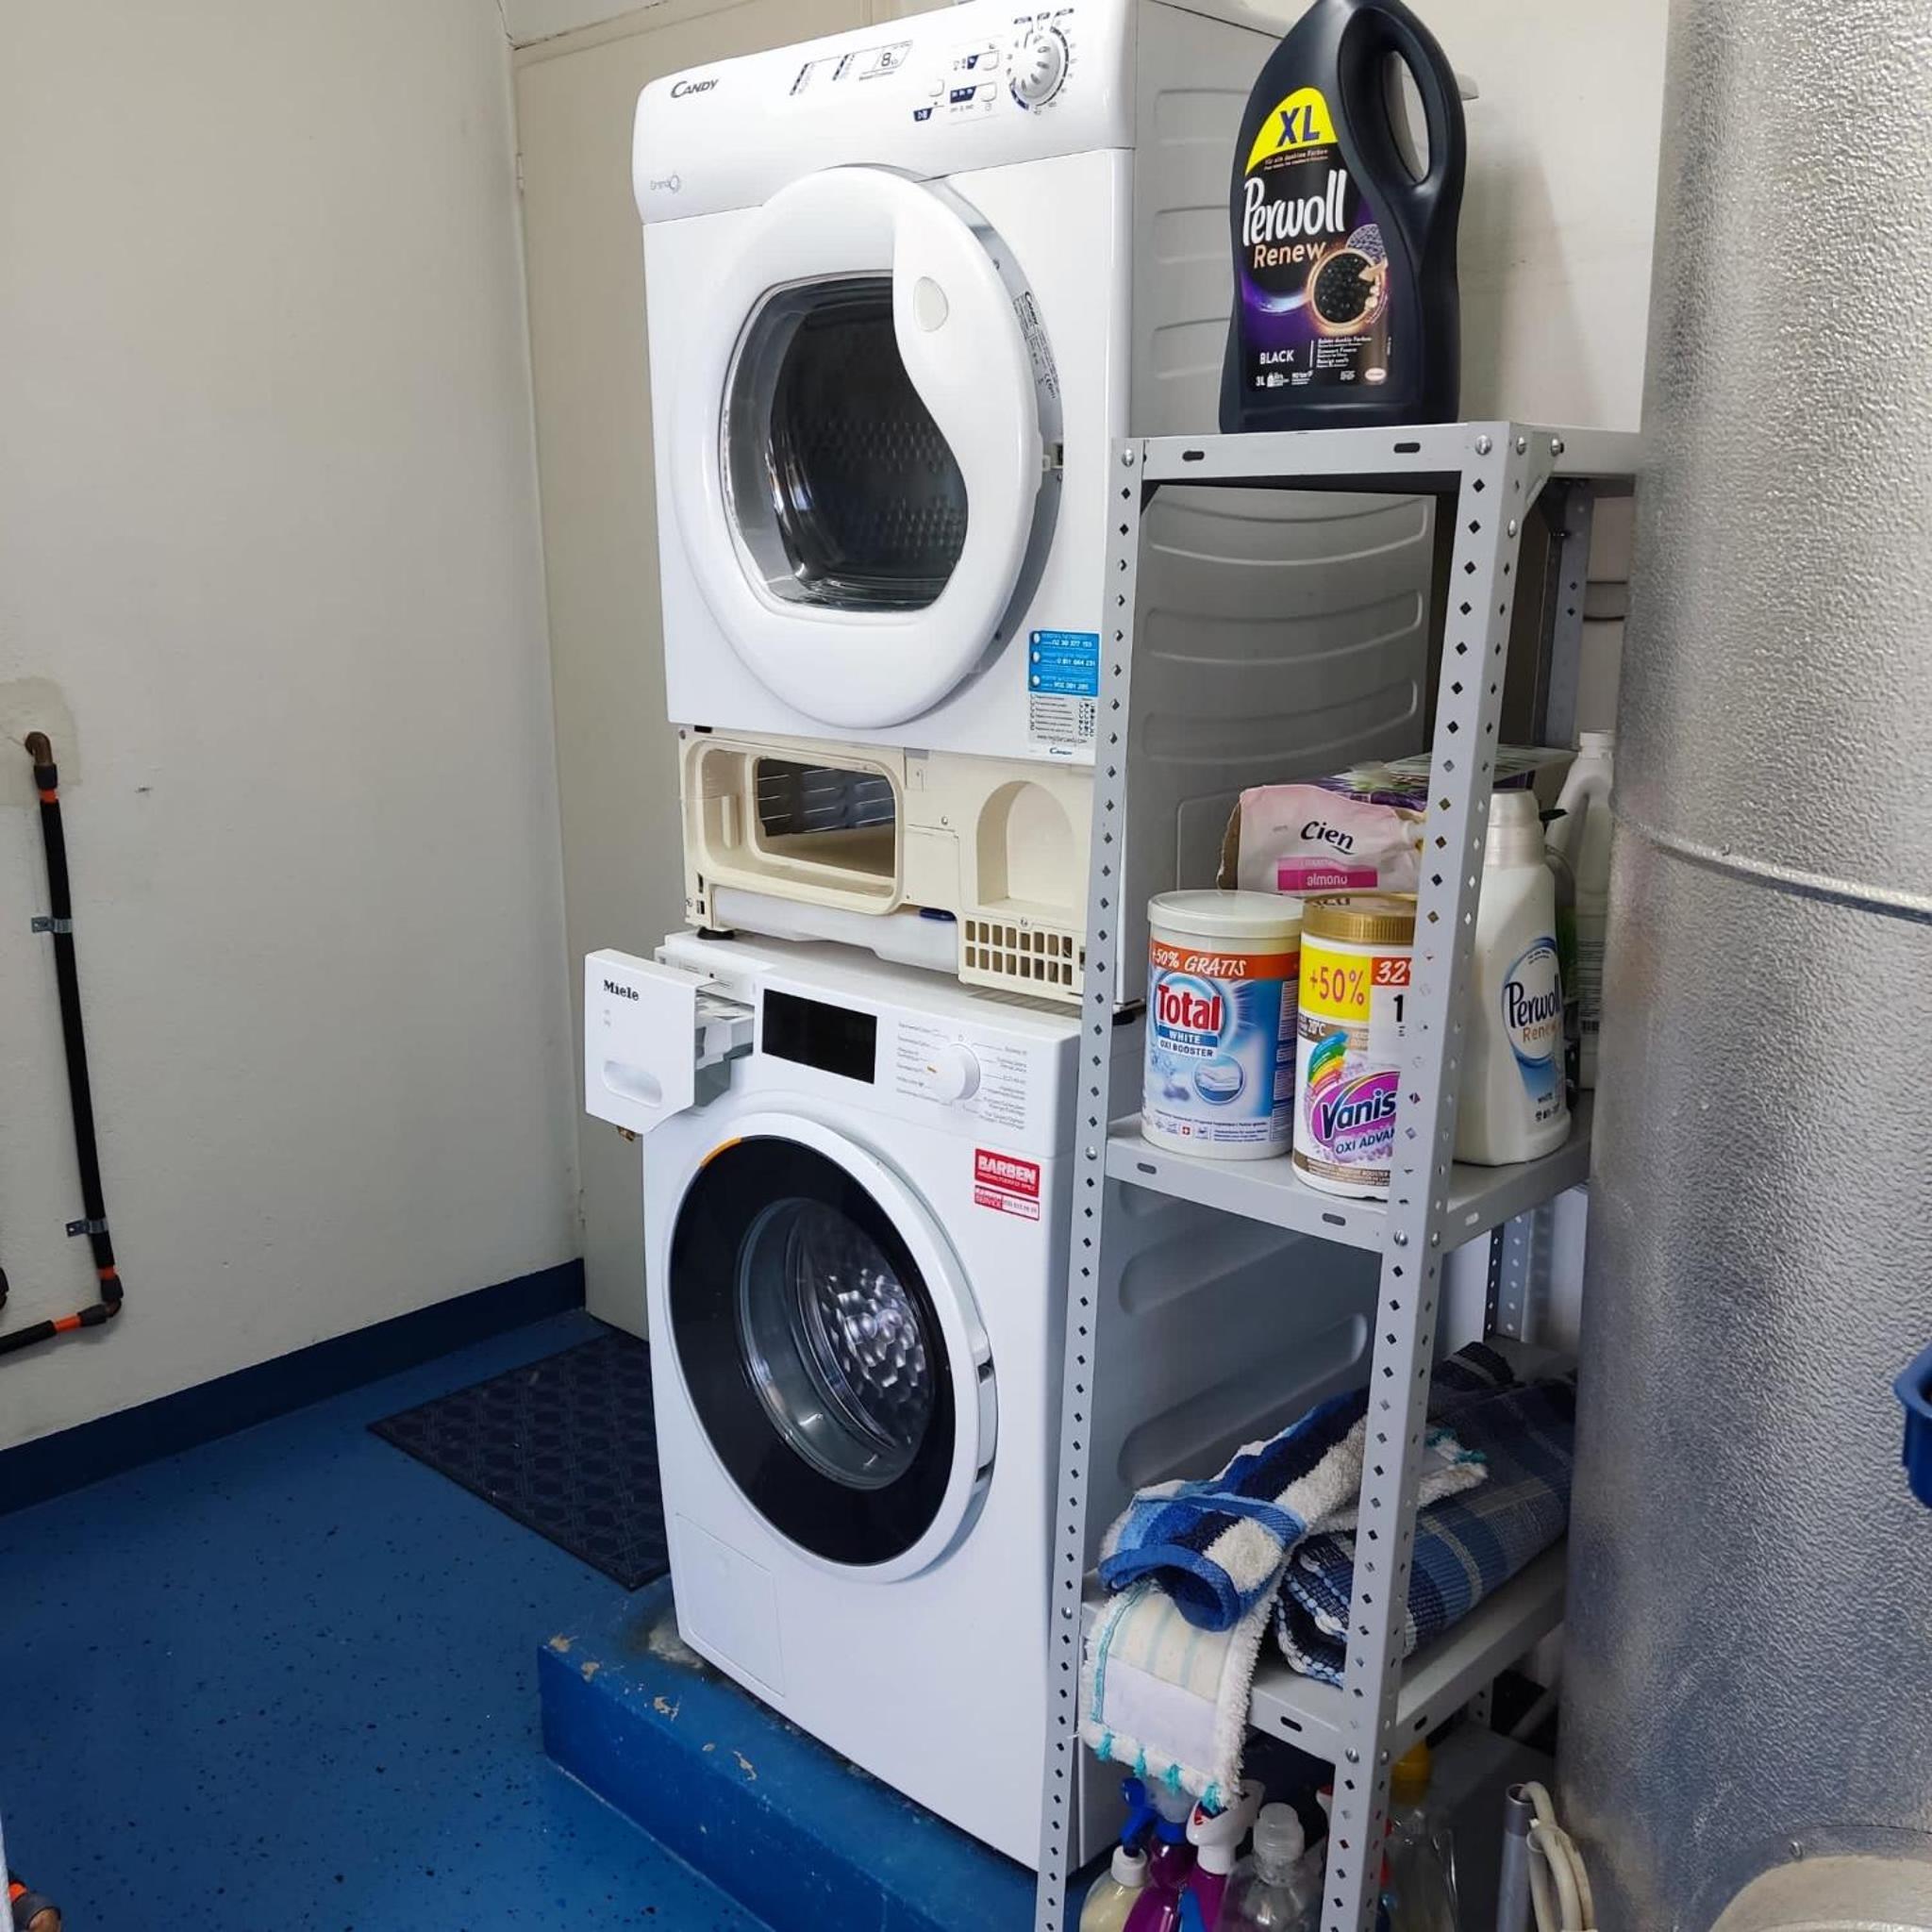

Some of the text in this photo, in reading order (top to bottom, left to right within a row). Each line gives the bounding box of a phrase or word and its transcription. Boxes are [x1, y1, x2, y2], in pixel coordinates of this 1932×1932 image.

[671, 78, 719, 98] CANDY
[1275, 105, 1320, 148] XL
[1242, 169, 1347, 246] Perwoll
[1254, 242, 1326, 269] Renew
[1259, 349, 1294, 365] BLACK
[1301, 821, 1355, 852] Cien
[1184, 955, 1248, 977] GRATIS
[604, 979, 640, 1002] Miele
[1309, 965, 1365, 1007] +50%
[1158, 984, 1222, 1032] Total
[1168, 1028, 1202, 1045] WHITE
[1173, 1042, 1214, 1058] BOOSTER
[1322, 1089, 1397, 1140] Vanis
[1336, 1140, 1357, 1154] OXI
[977, 1154, 1037, 1185] BARBEN
